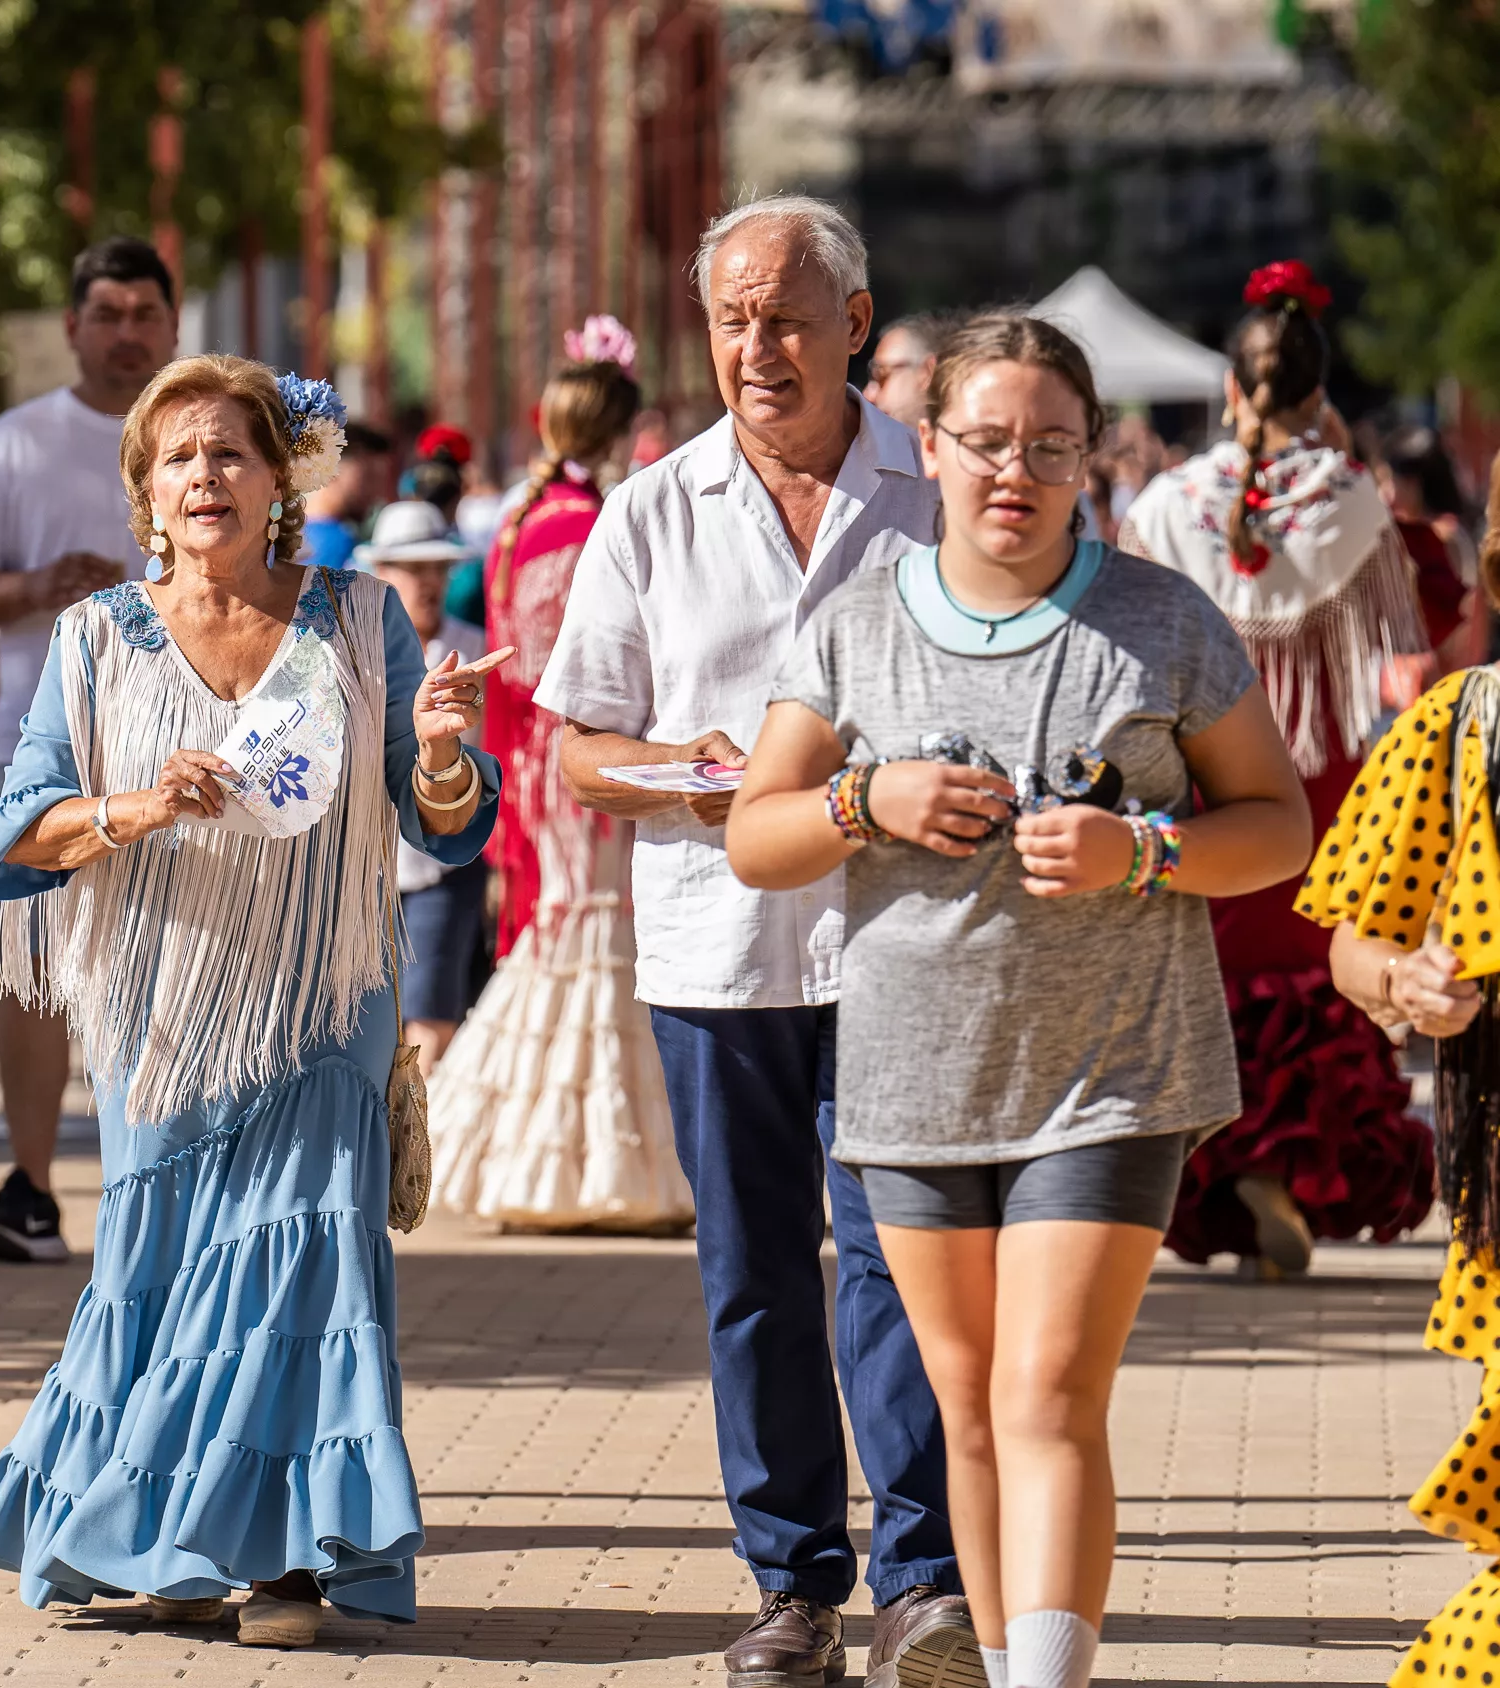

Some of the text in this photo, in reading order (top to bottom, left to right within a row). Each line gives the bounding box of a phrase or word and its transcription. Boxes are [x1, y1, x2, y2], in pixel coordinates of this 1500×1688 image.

[275, 727, 292, 751] SERVICIO
[280, 745, 290, 758] 711
[272, 756, 282, 768] 72
[265, 766, 275, 778] 47
